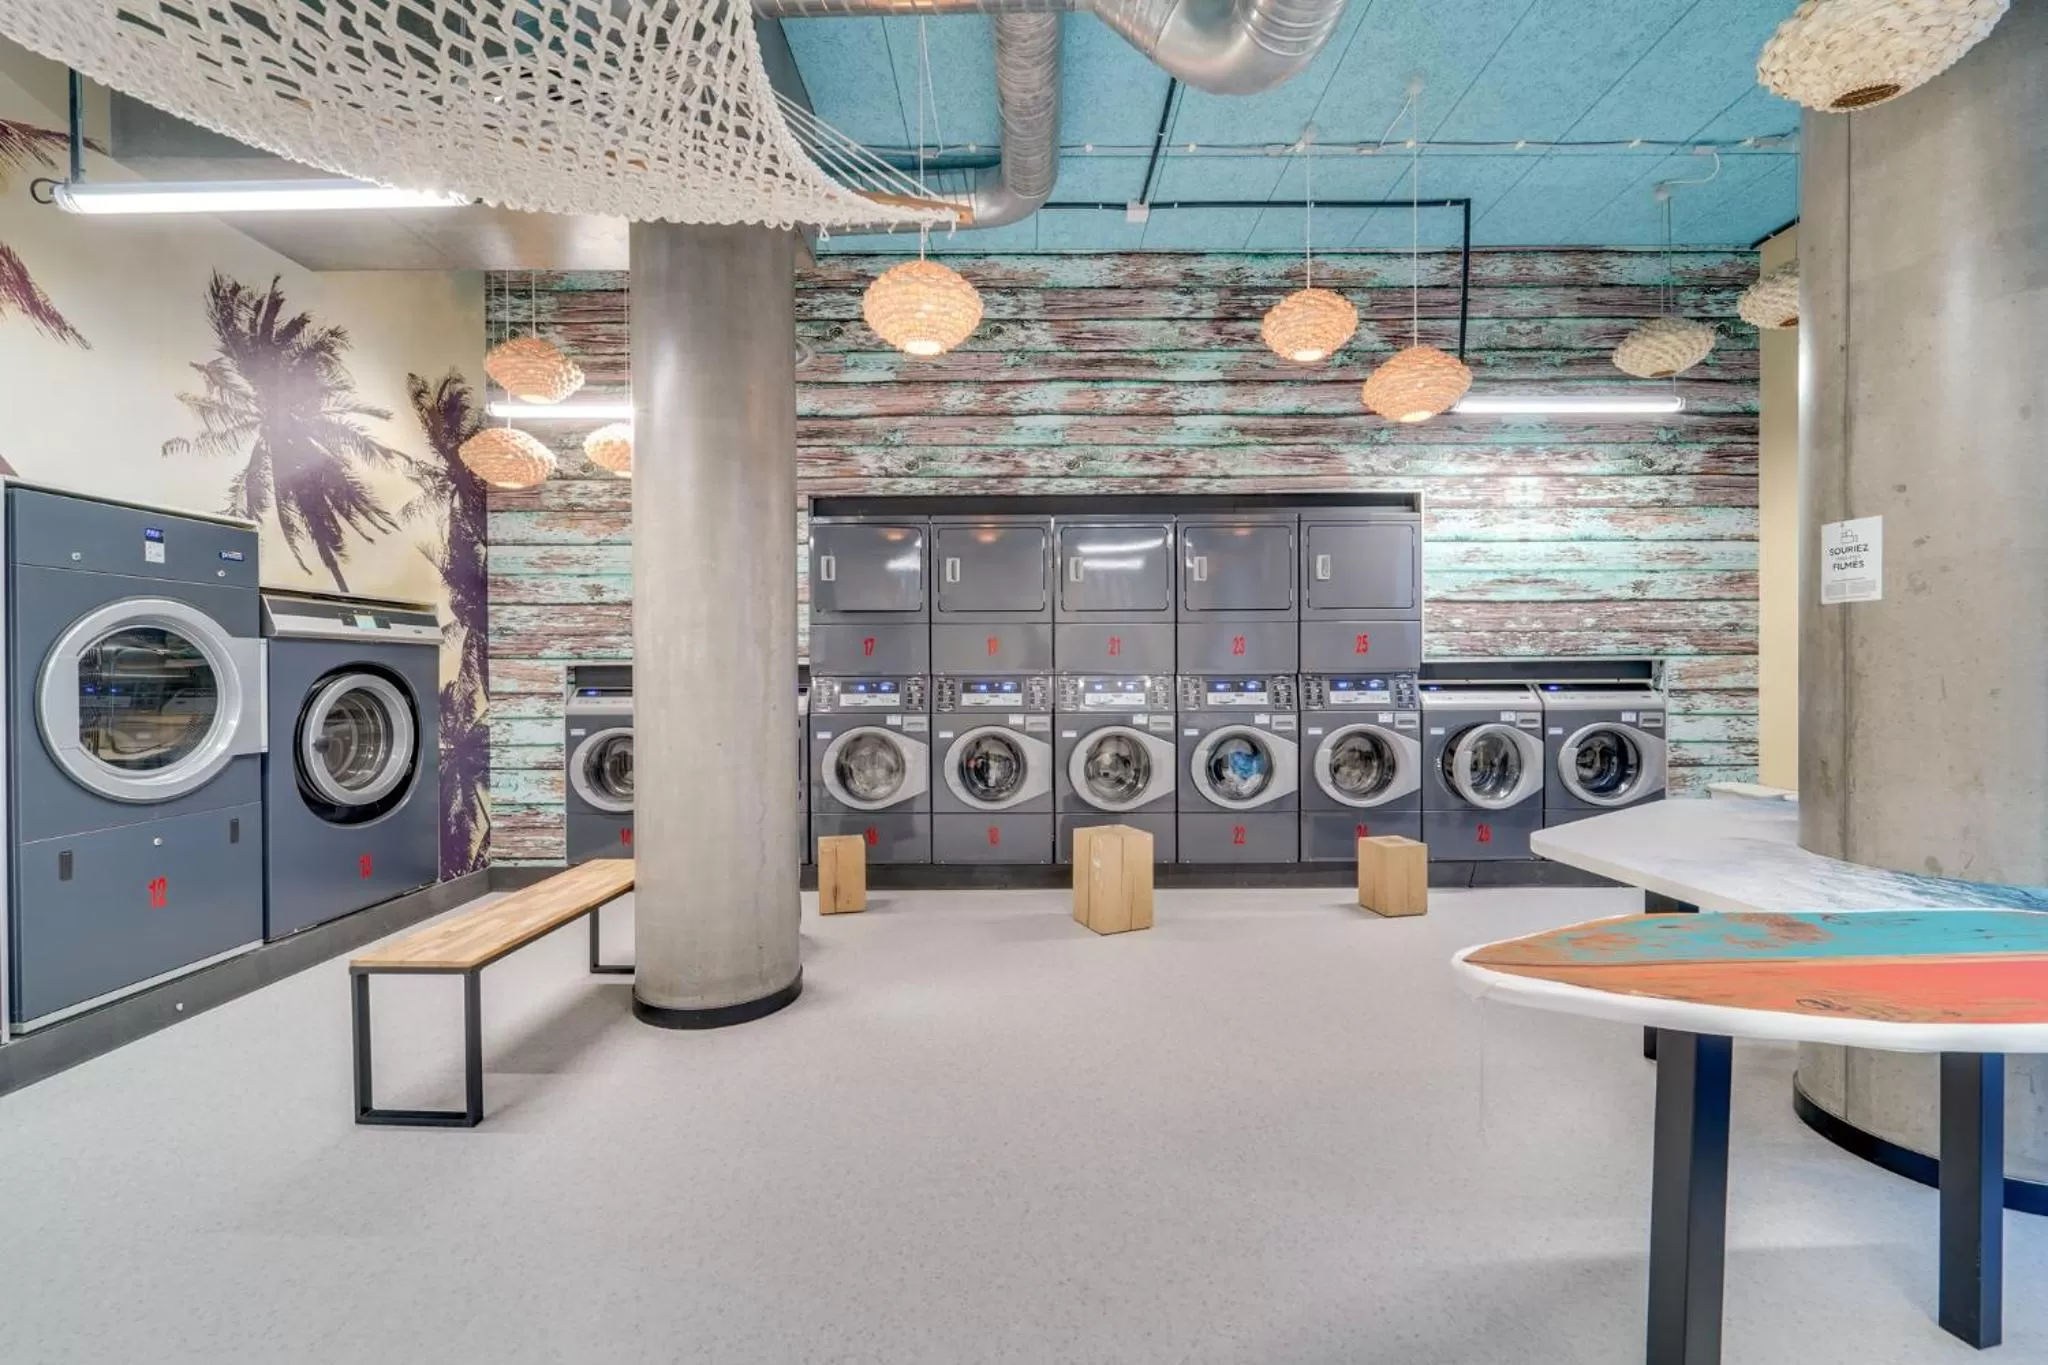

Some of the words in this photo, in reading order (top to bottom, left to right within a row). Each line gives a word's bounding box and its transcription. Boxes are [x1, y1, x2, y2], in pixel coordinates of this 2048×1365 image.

[1829, 543, 1869, 556] SOURIEZ
[864, 637, 876, 656] 17
[1109, 637, 1121, 656] 21
[1233, 636, 1246, 656] 23
[1355, 633, 1370, 655] 25
[1233, 825, 1247, 846] 22
[1478, 824, 1491, 844] 26
